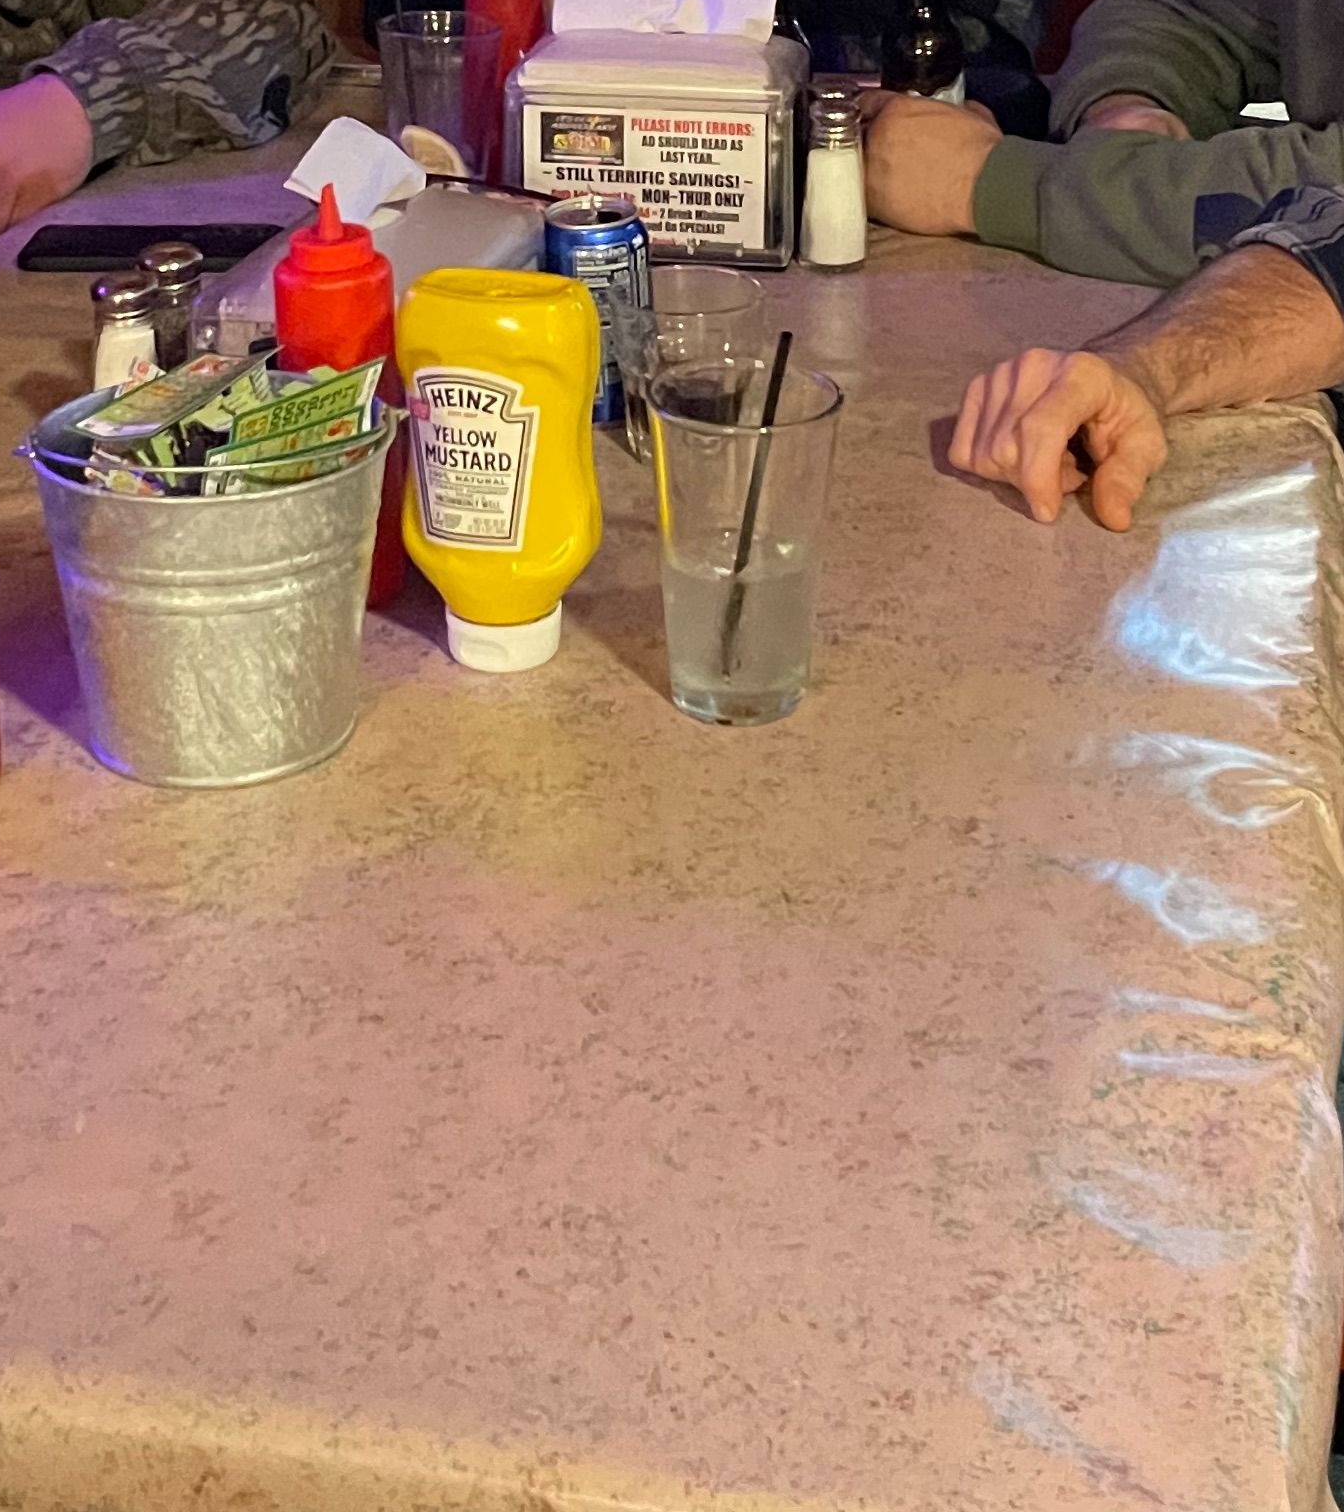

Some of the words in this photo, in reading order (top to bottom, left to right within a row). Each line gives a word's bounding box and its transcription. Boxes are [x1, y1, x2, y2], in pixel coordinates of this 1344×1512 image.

[631, 118, 671, 132] PLEASE
[673, 120, 703, 134] NOTE
[706, 121, 755, 137] ERRORS:
[641, 135, 655, 147] AD
[658, 136, 699, 150] SHOULD
[701, 138, 727, 151] READ
[730, 140, 743, 151] AS
[660, 151, 685, 164] LAST
[556, 166, 594, 182] STILL
[598, 169, 664, 185] TERRIFIC
[669, 172, 740, 188] SAVINGS!
[714, 192, 745, 207] ONLY
[430, 388, 498, 414] HEINZ
[433, 423, 497, 448] YELLOW
[425, 441, 512, 472] MUSTARD
